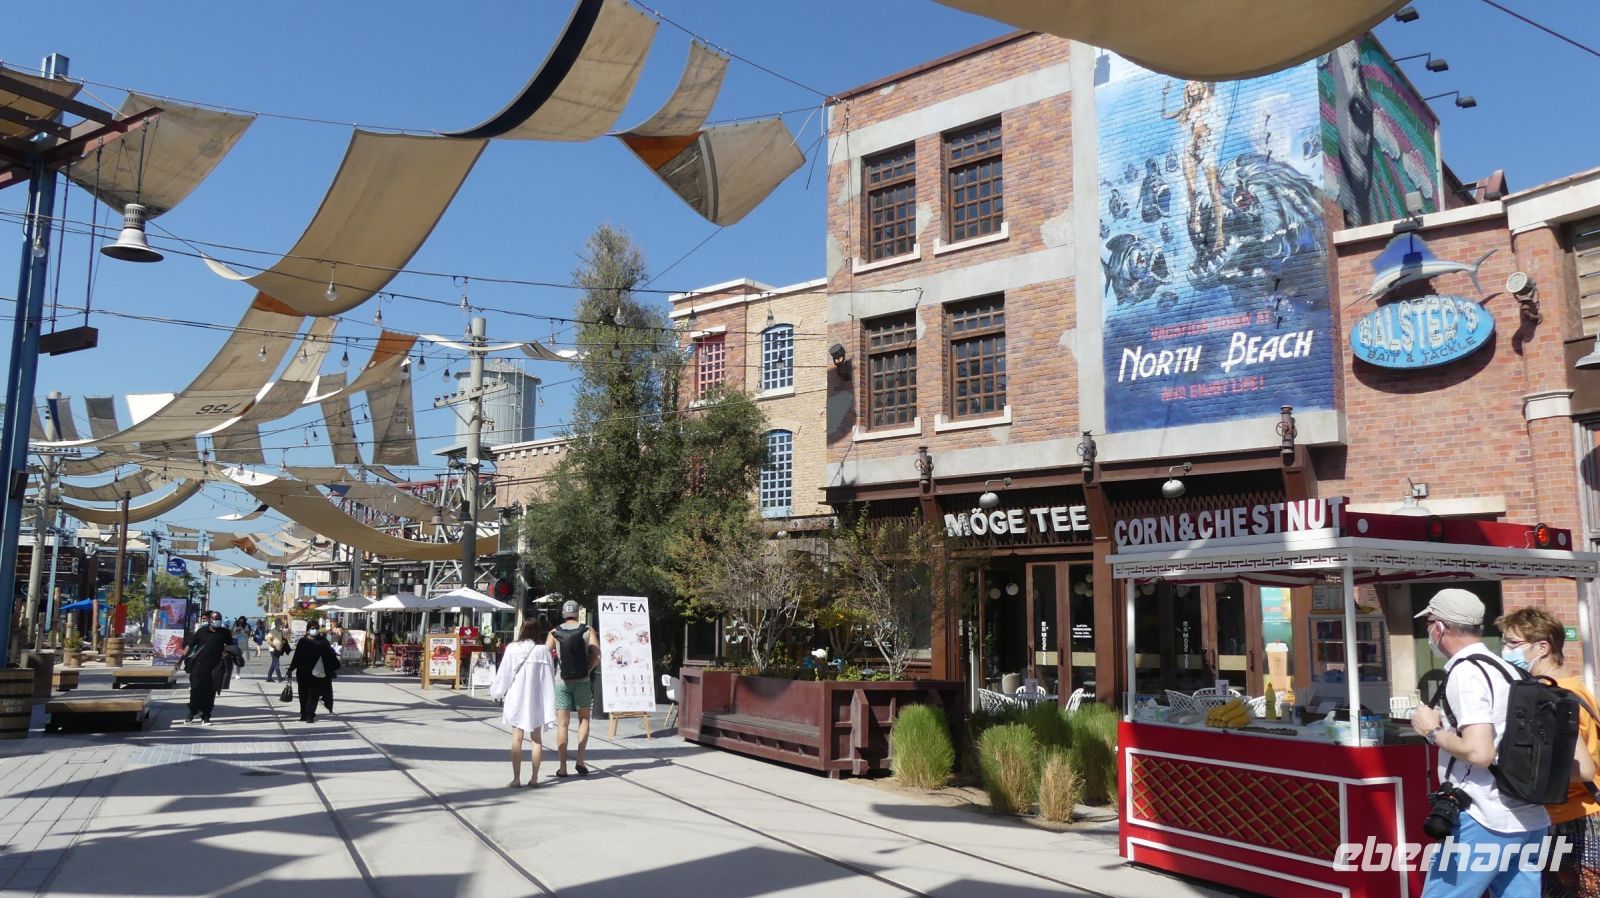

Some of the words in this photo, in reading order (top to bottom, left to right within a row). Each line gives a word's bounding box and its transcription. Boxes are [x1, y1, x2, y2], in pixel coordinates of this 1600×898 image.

[1117, 345, 1202, 383] NORTH
[1221, 330, 1314, 373] BEACH
[1367, 347, 1400, 363] BAIT
[1423, 336, 1477, 364] TACKLE
[944, 507, 1027, 537] MÖGE
[1030, 505, 1091, 533] TEE
